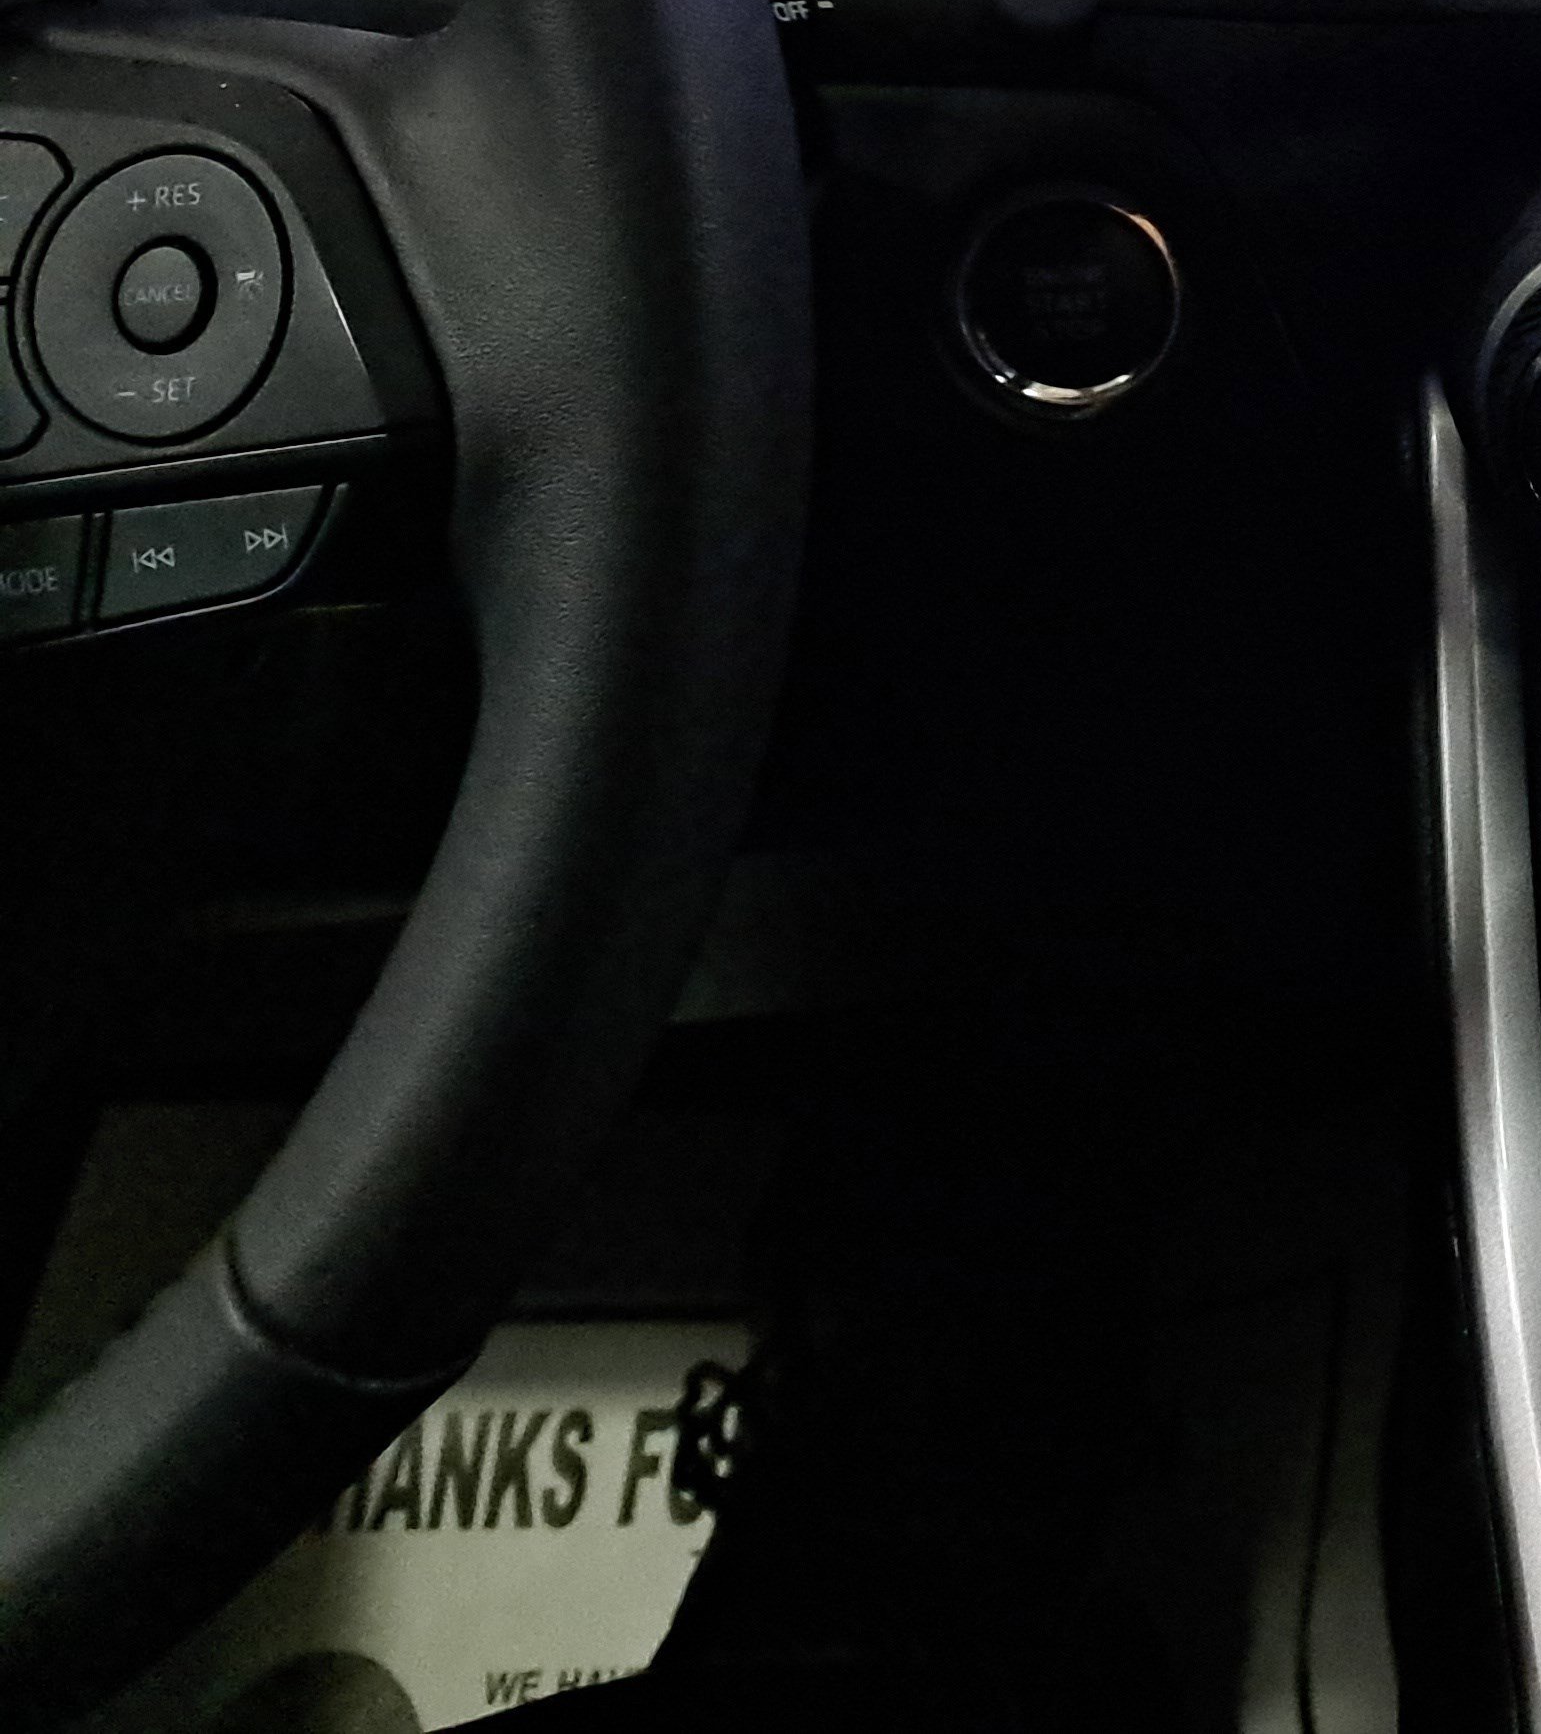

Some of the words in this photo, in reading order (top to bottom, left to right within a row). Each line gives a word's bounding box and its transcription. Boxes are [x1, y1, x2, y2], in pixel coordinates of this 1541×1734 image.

[773, 0, 809, 22] OFF
[155, 182, 201, 207] RES
[123, 283, 193, 306] CANCEL
[152, 377, 197, 403] SET
